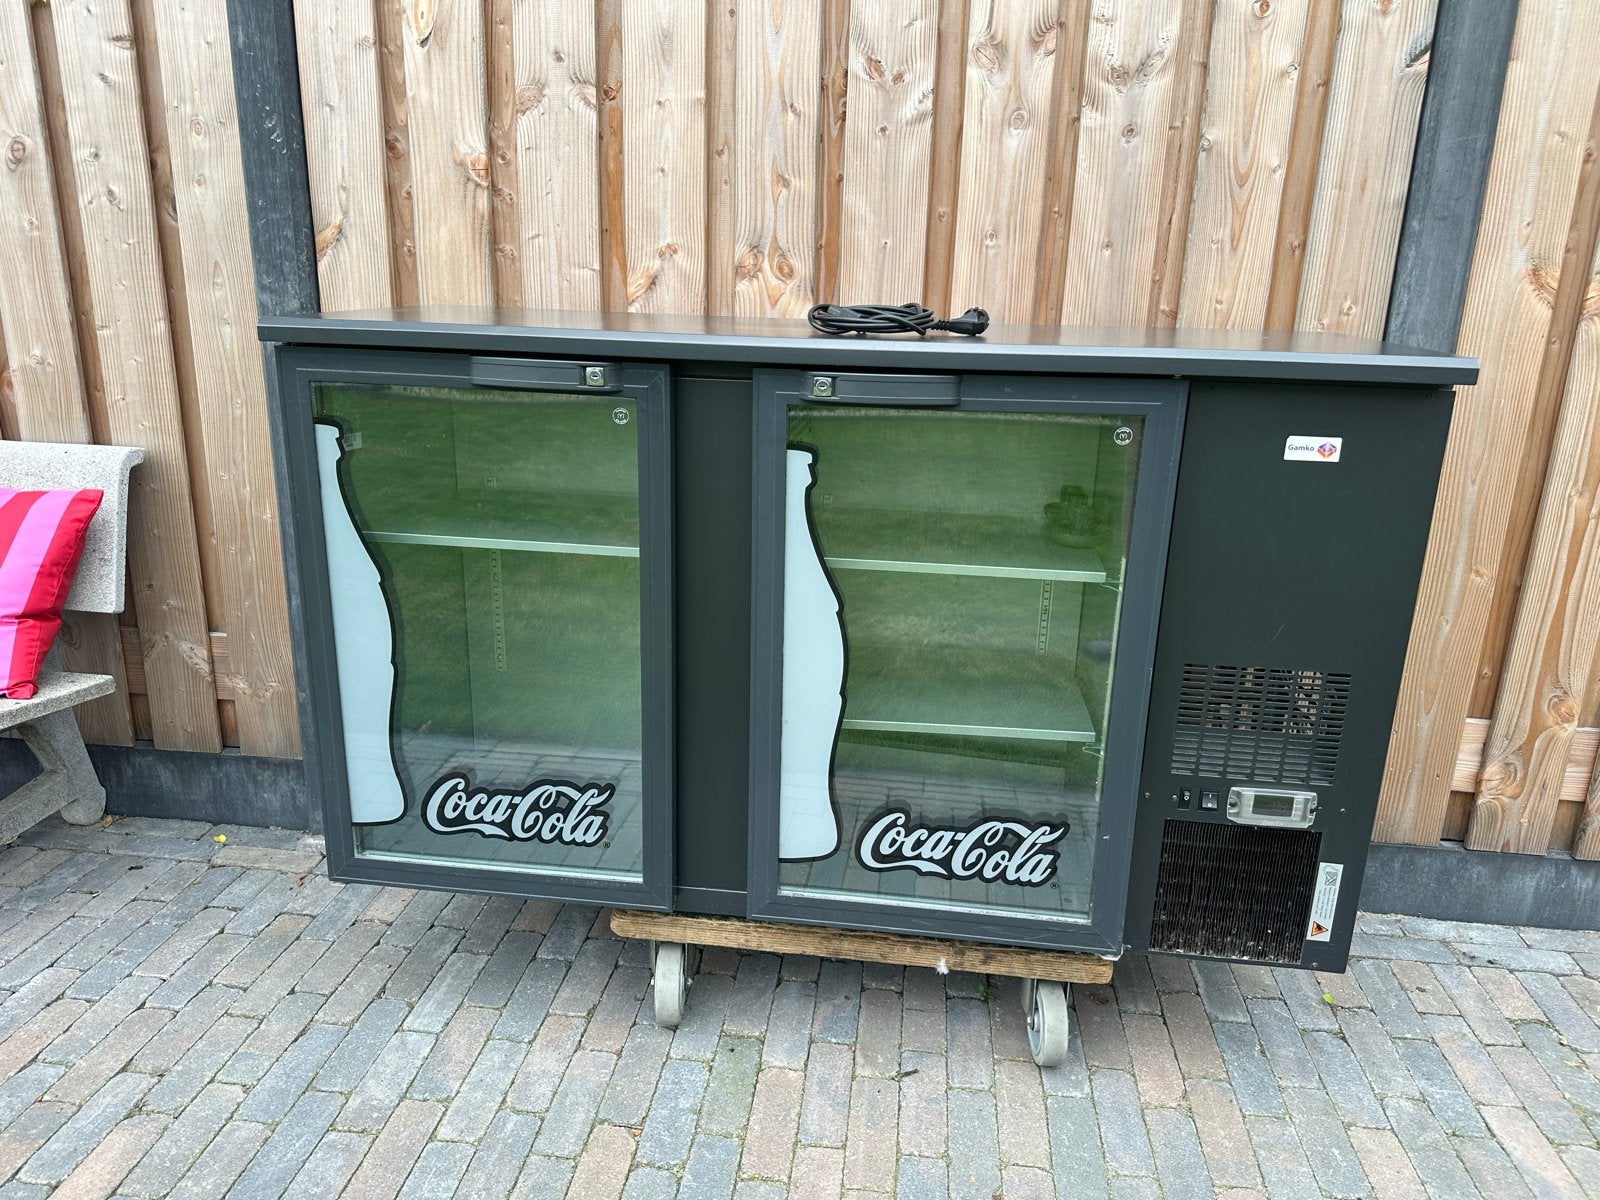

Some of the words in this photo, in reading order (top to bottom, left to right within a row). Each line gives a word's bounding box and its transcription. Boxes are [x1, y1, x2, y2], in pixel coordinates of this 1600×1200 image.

[1287, 443, 1315, 452] Gamko
[426, 777, 611, 844] Coca-Cola
[860, 812, 1065, 883] Coca-Cola
